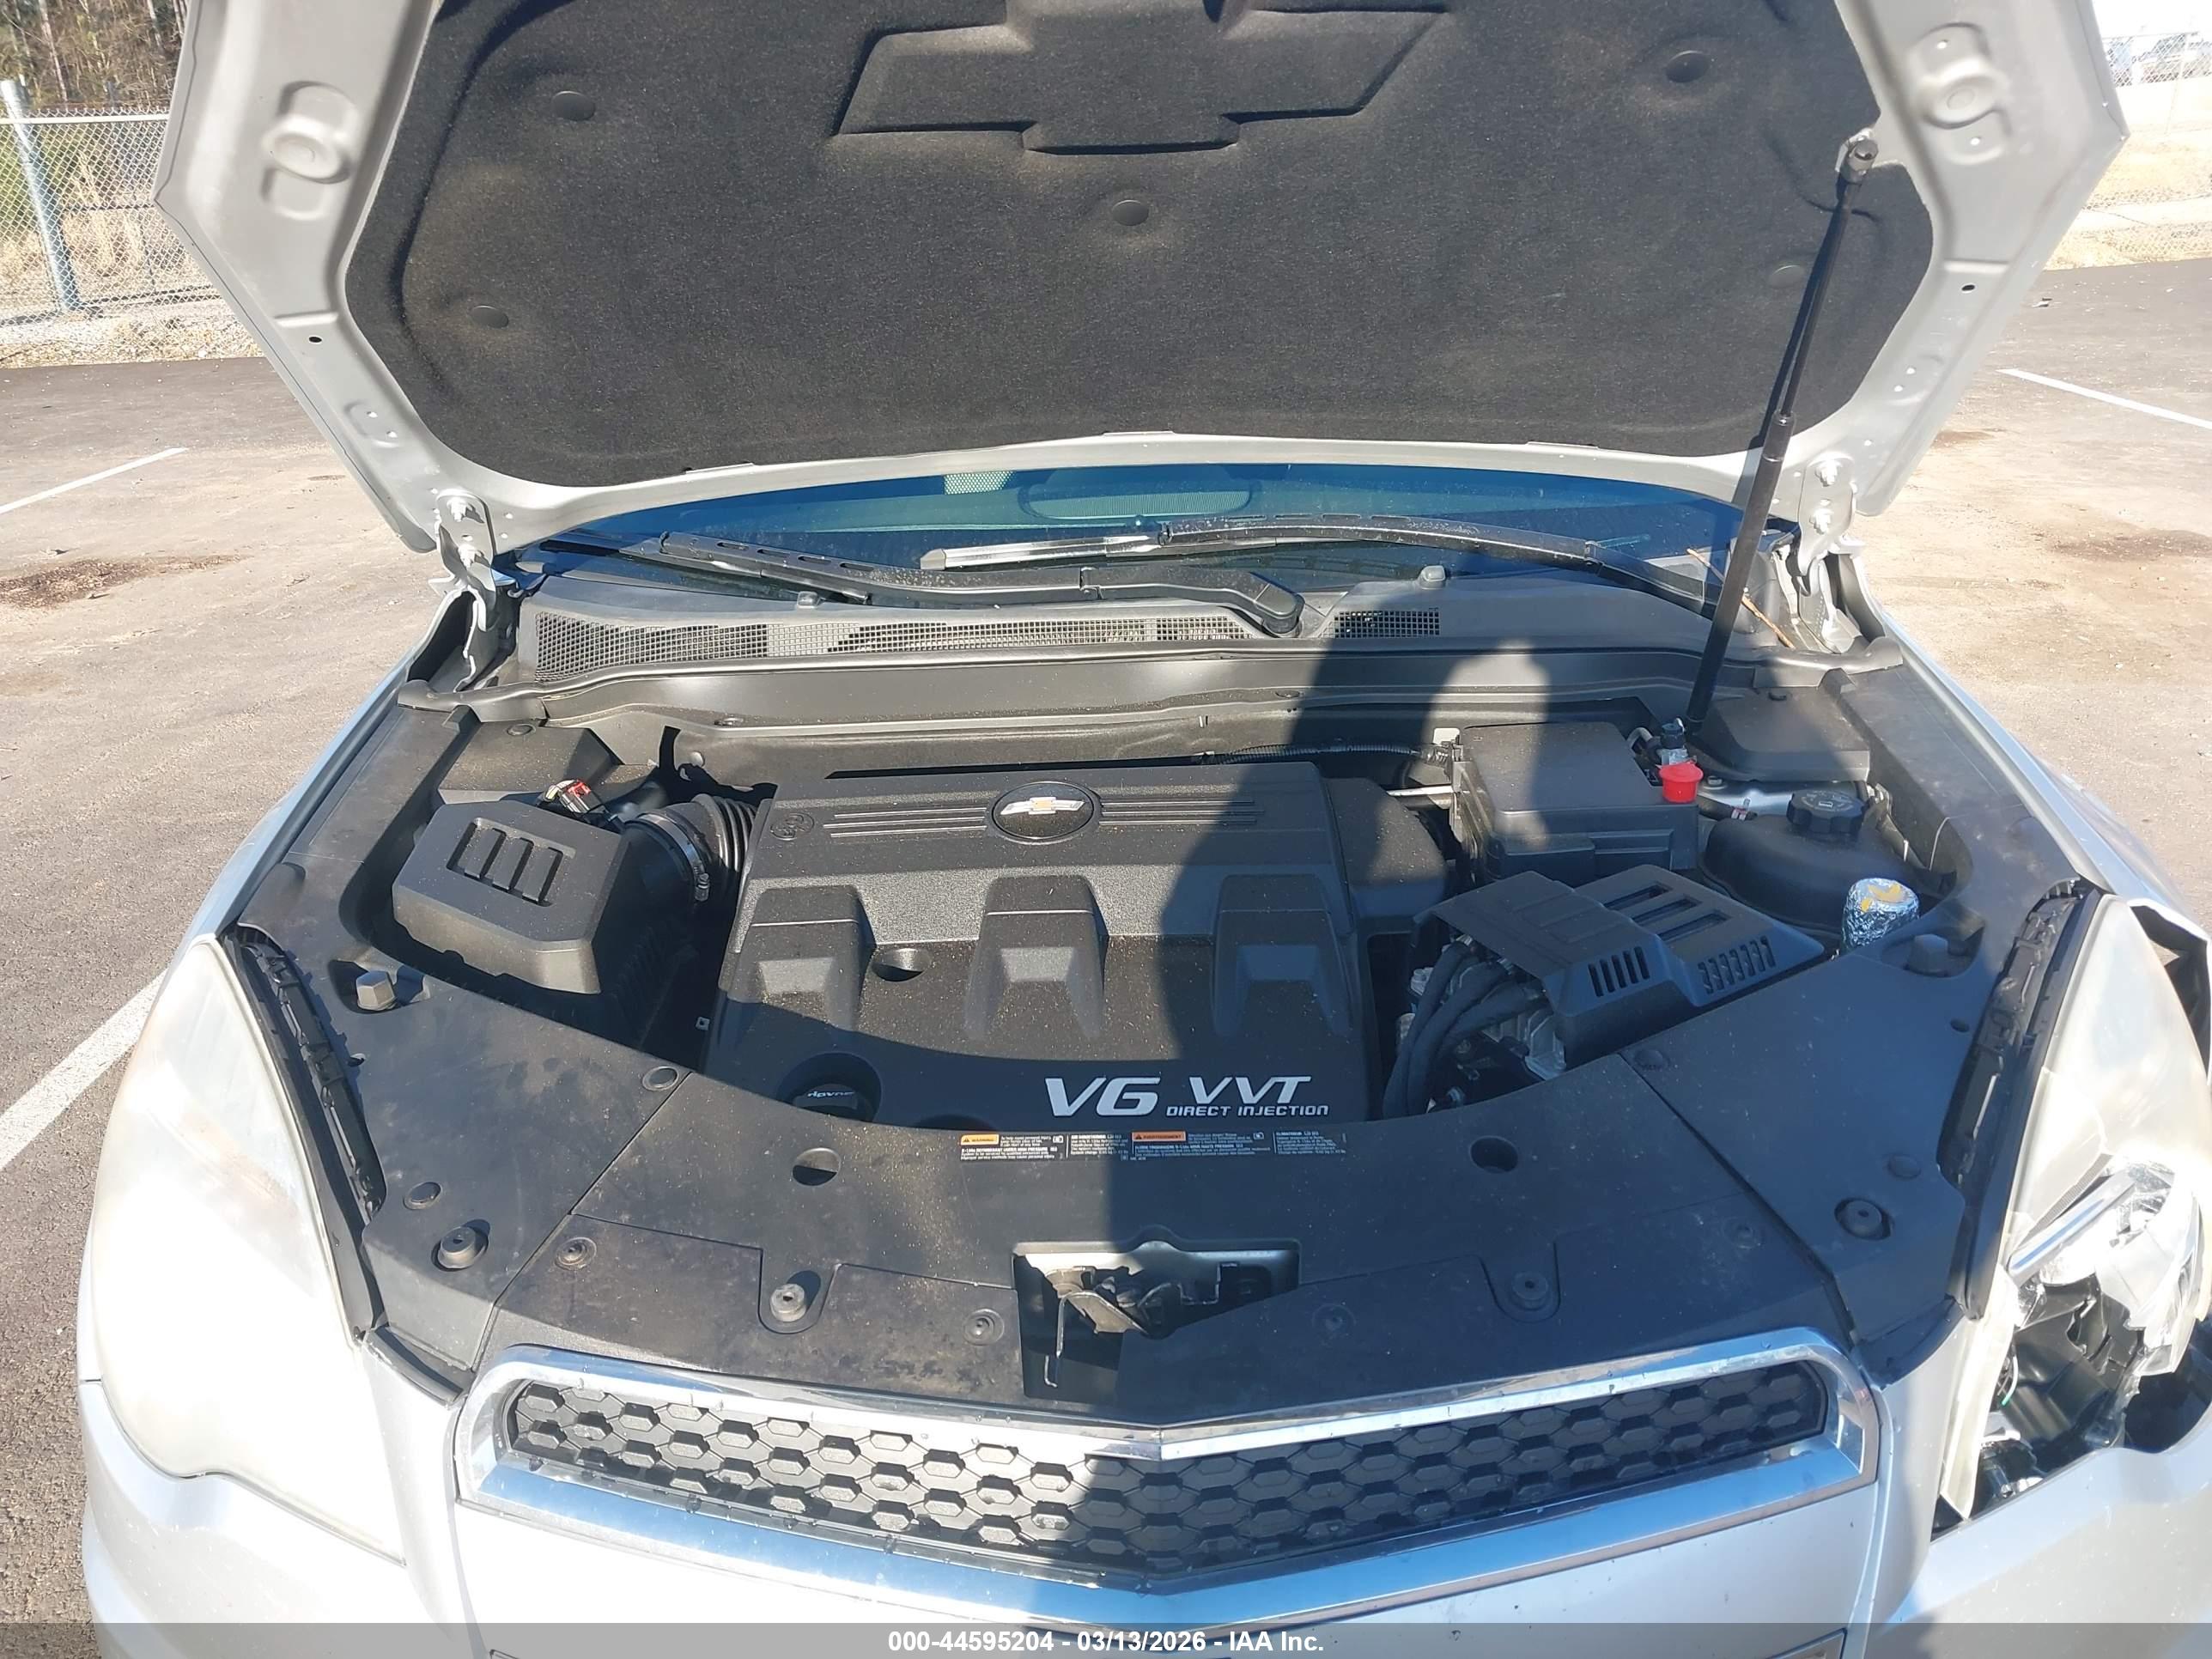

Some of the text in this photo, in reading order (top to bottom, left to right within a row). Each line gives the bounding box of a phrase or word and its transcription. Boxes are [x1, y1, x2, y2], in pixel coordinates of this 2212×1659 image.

[1044, 1076, 1312, 1116] V6 VVT
[1166, 1104, 1328, 1116] DIRECT INJECTION
